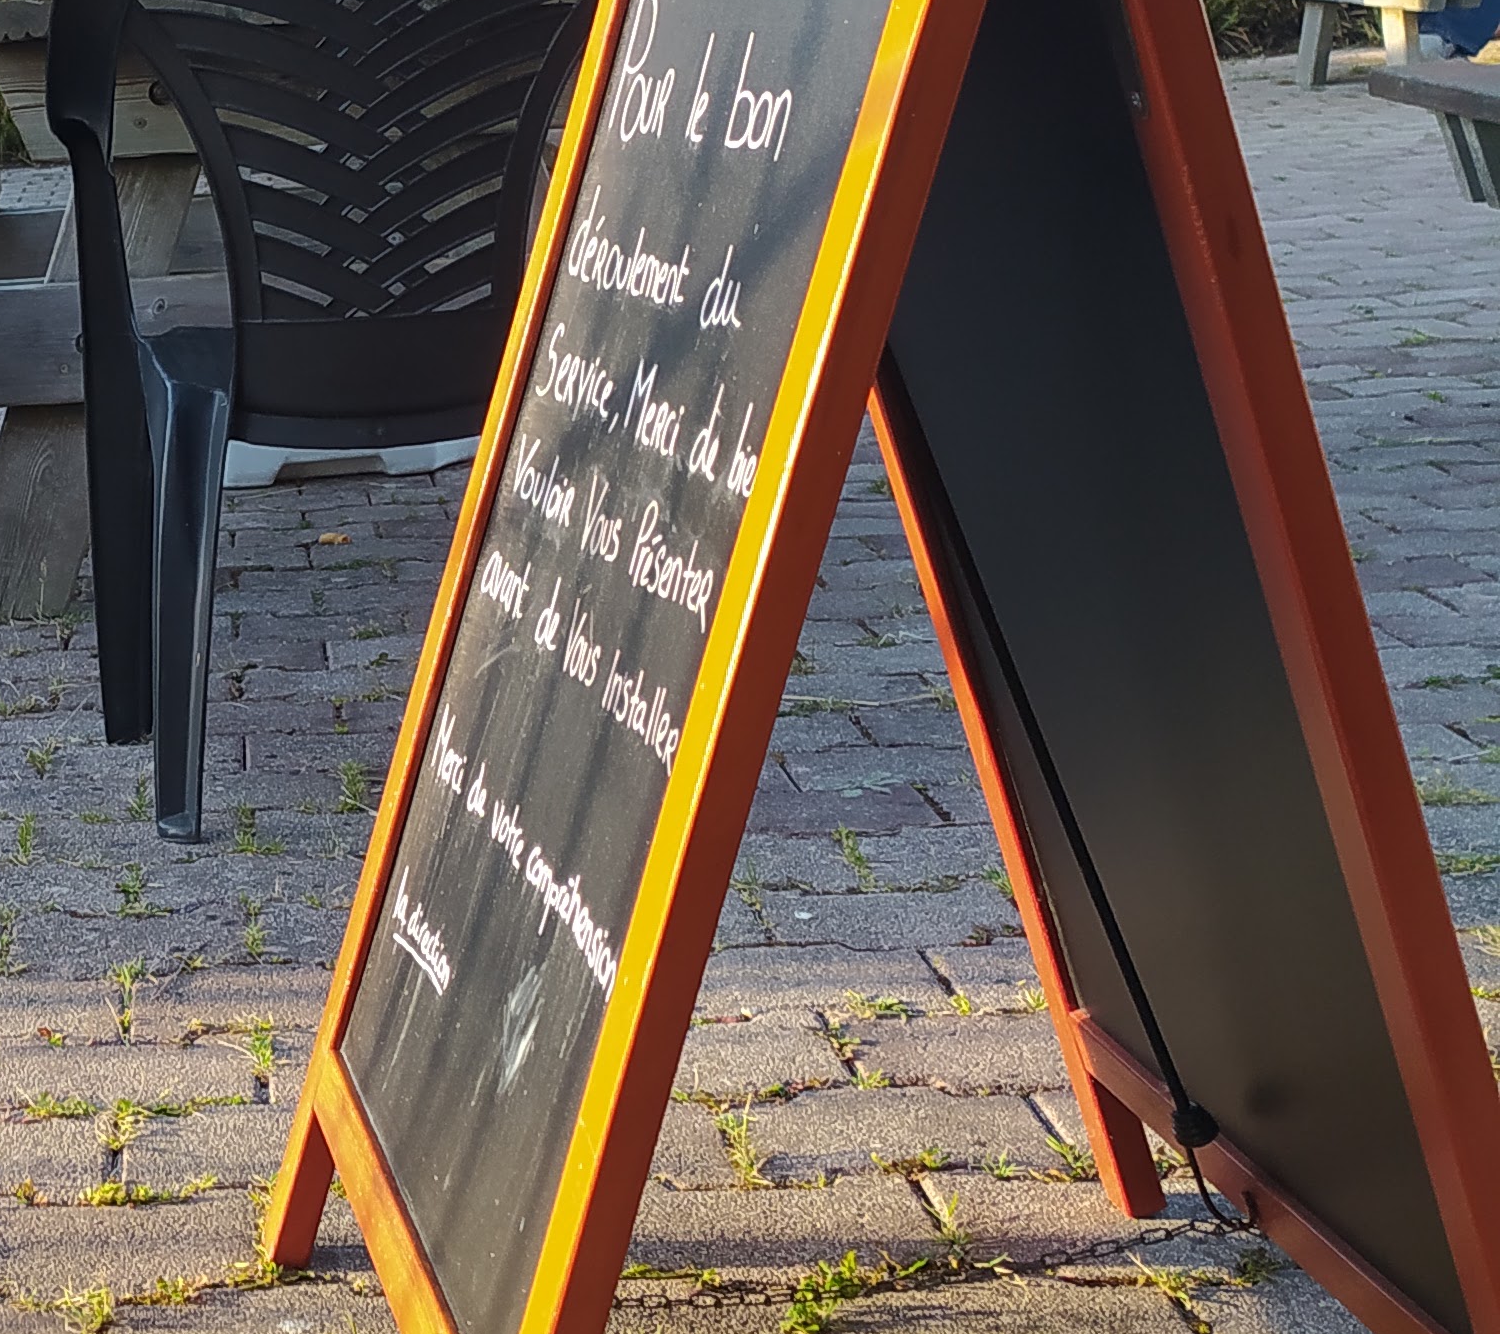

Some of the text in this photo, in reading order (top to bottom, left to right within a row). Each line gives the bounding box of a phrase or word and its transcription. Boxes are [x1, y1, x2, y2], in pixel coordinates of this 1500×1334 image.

[684, 31, 715, 143] le
[724, 30, 793, 163] bon
[700, 243, 743, 330] du
[688, 383, 727, 482] de
[580, 474, 624, 563] Vous
[480, 549, 532, 620] avant
[534, 576, 562, 652] de
[562, 597, 602, 688] Vous
[466, 761, 488, 819] de
